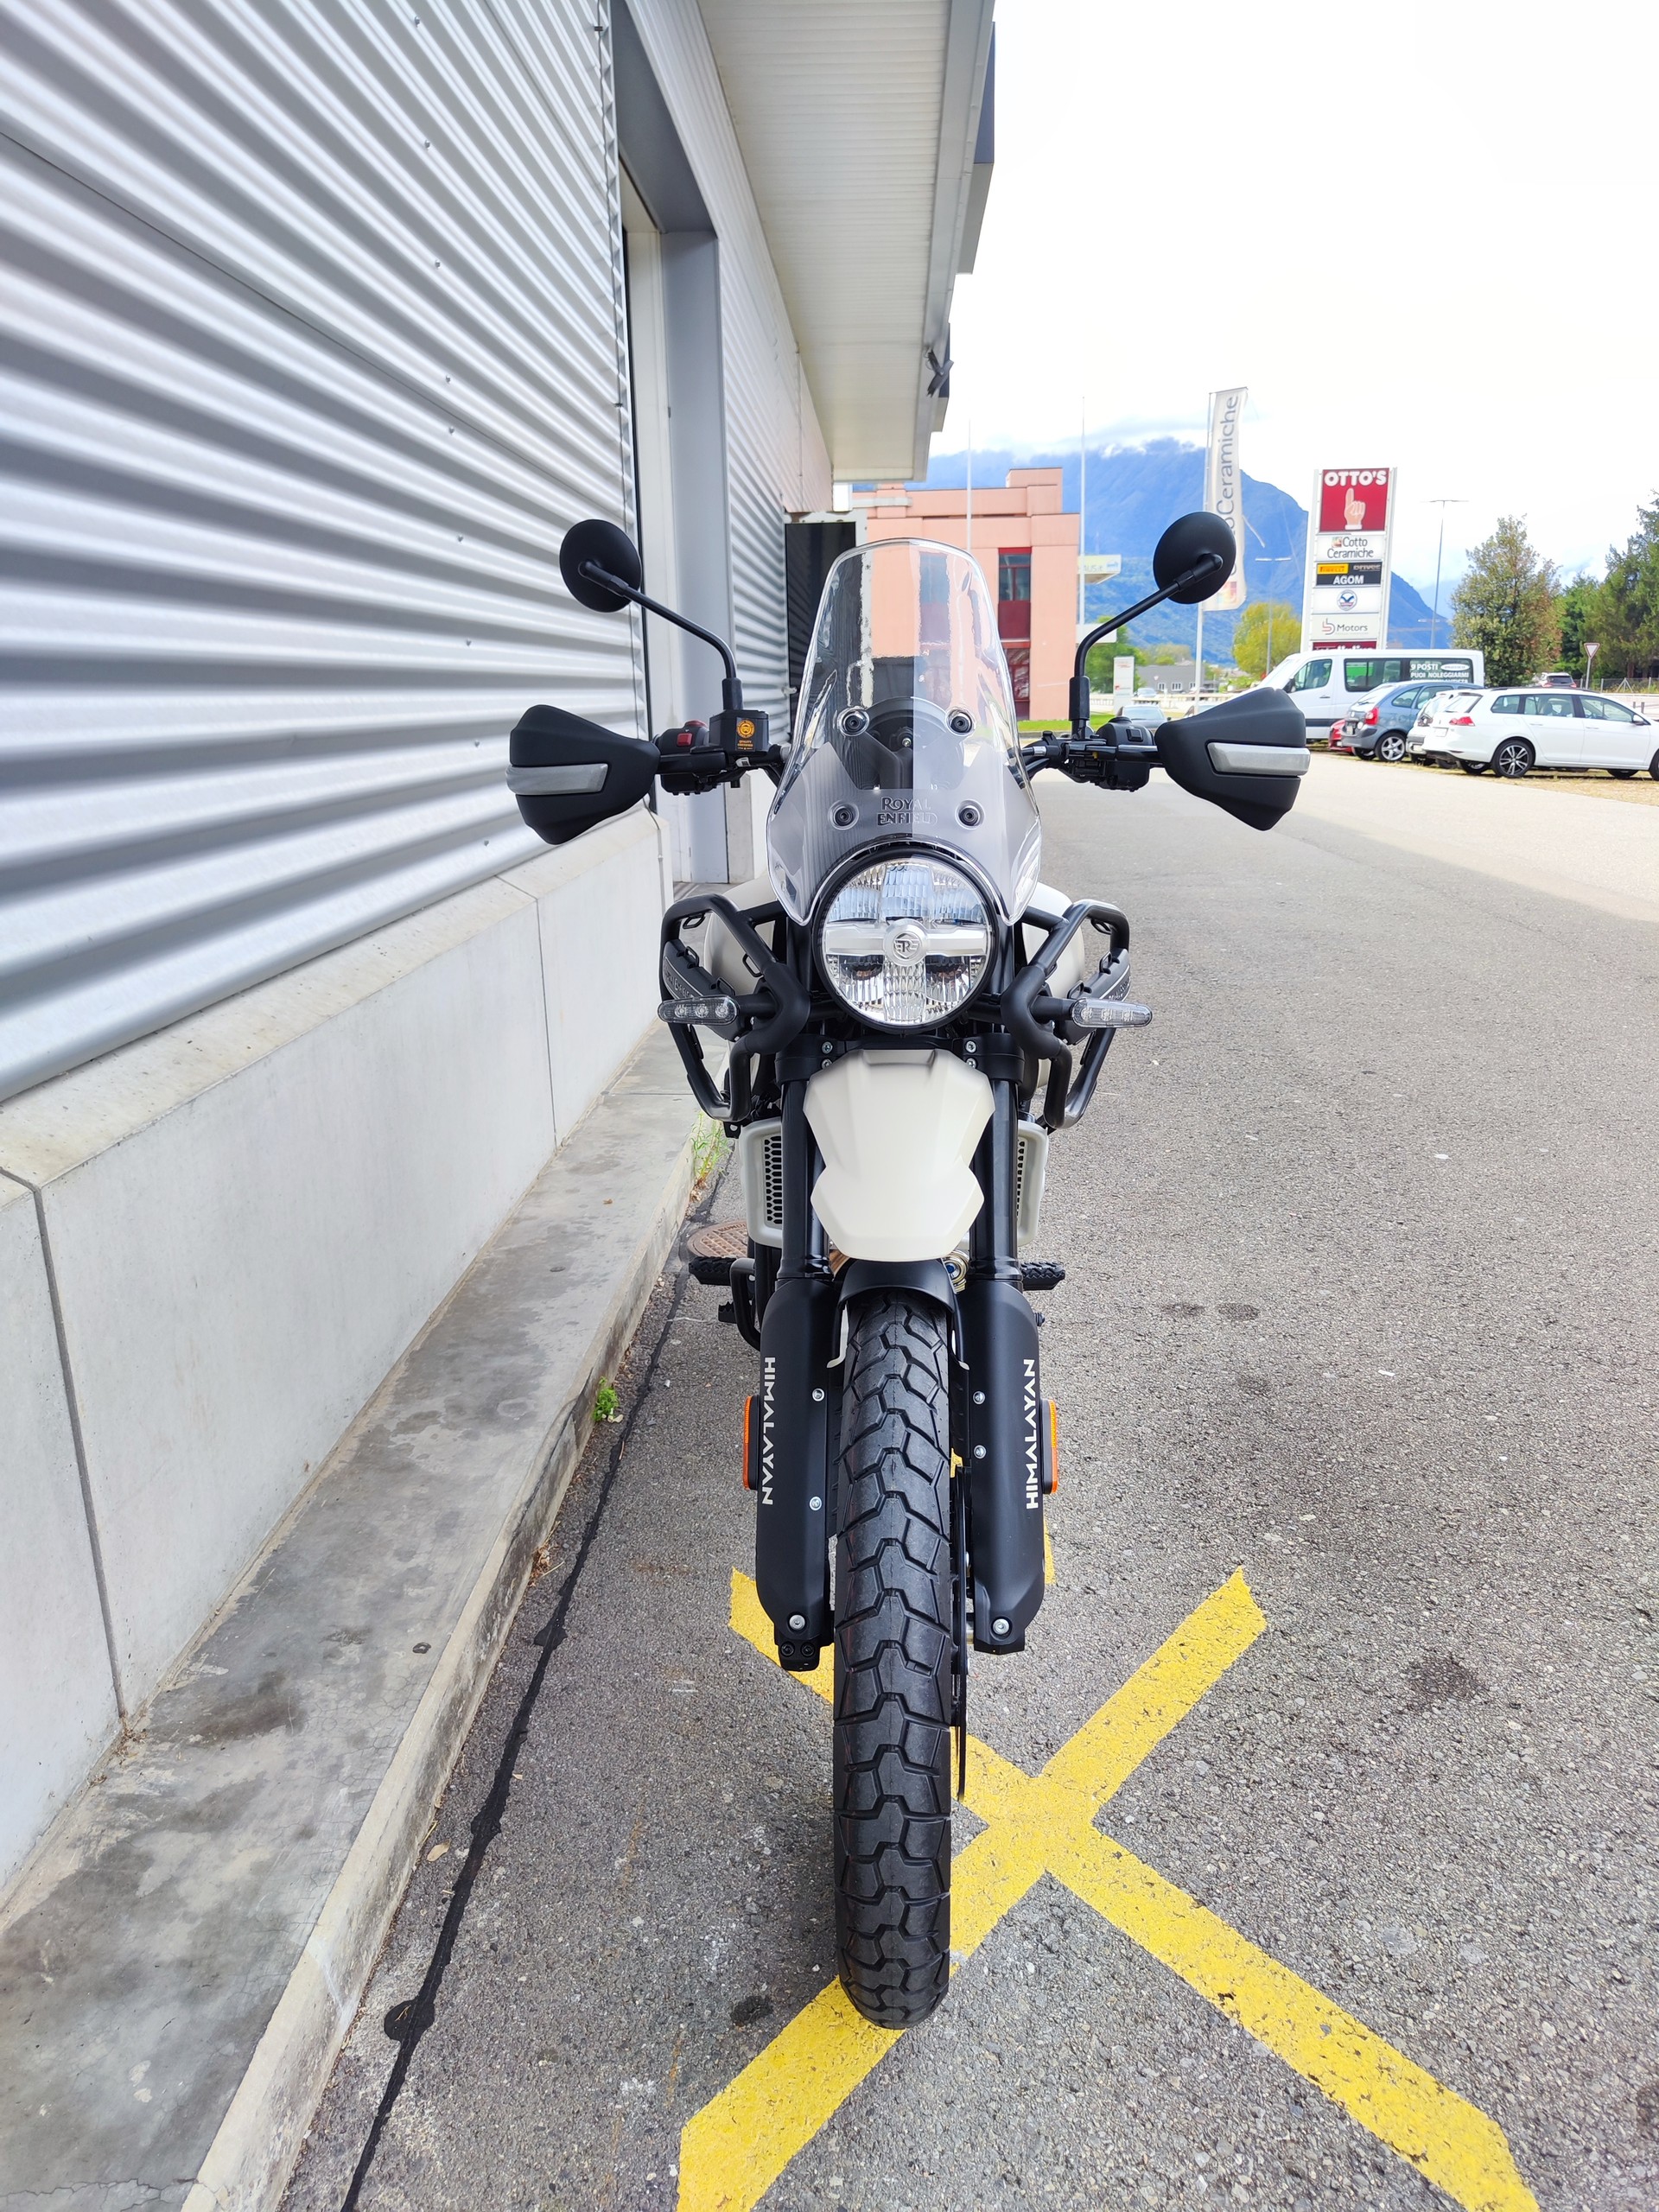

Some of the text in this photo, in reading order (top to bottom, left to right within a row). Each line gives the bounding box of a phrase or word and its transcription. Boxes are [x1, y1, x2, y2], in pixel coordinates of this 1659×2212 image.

[1216, 395, 1238, 515] Ceramiche
[1324, 470, 1387, 486] OTTO'S
[1342, 537, 1368, 548] Cotto
[1327, 548, 1374, 558] Ceramiche
[1332, 575, 1364, 585] AGOM
[881, 796, 931, 811] ROYAL
[877, 811, 938, 826] ENFIELD
[761, 1357, 776, 1505] HIMALAYAN
[1023, 1358, 1039, 1510] HIMALAYAN
